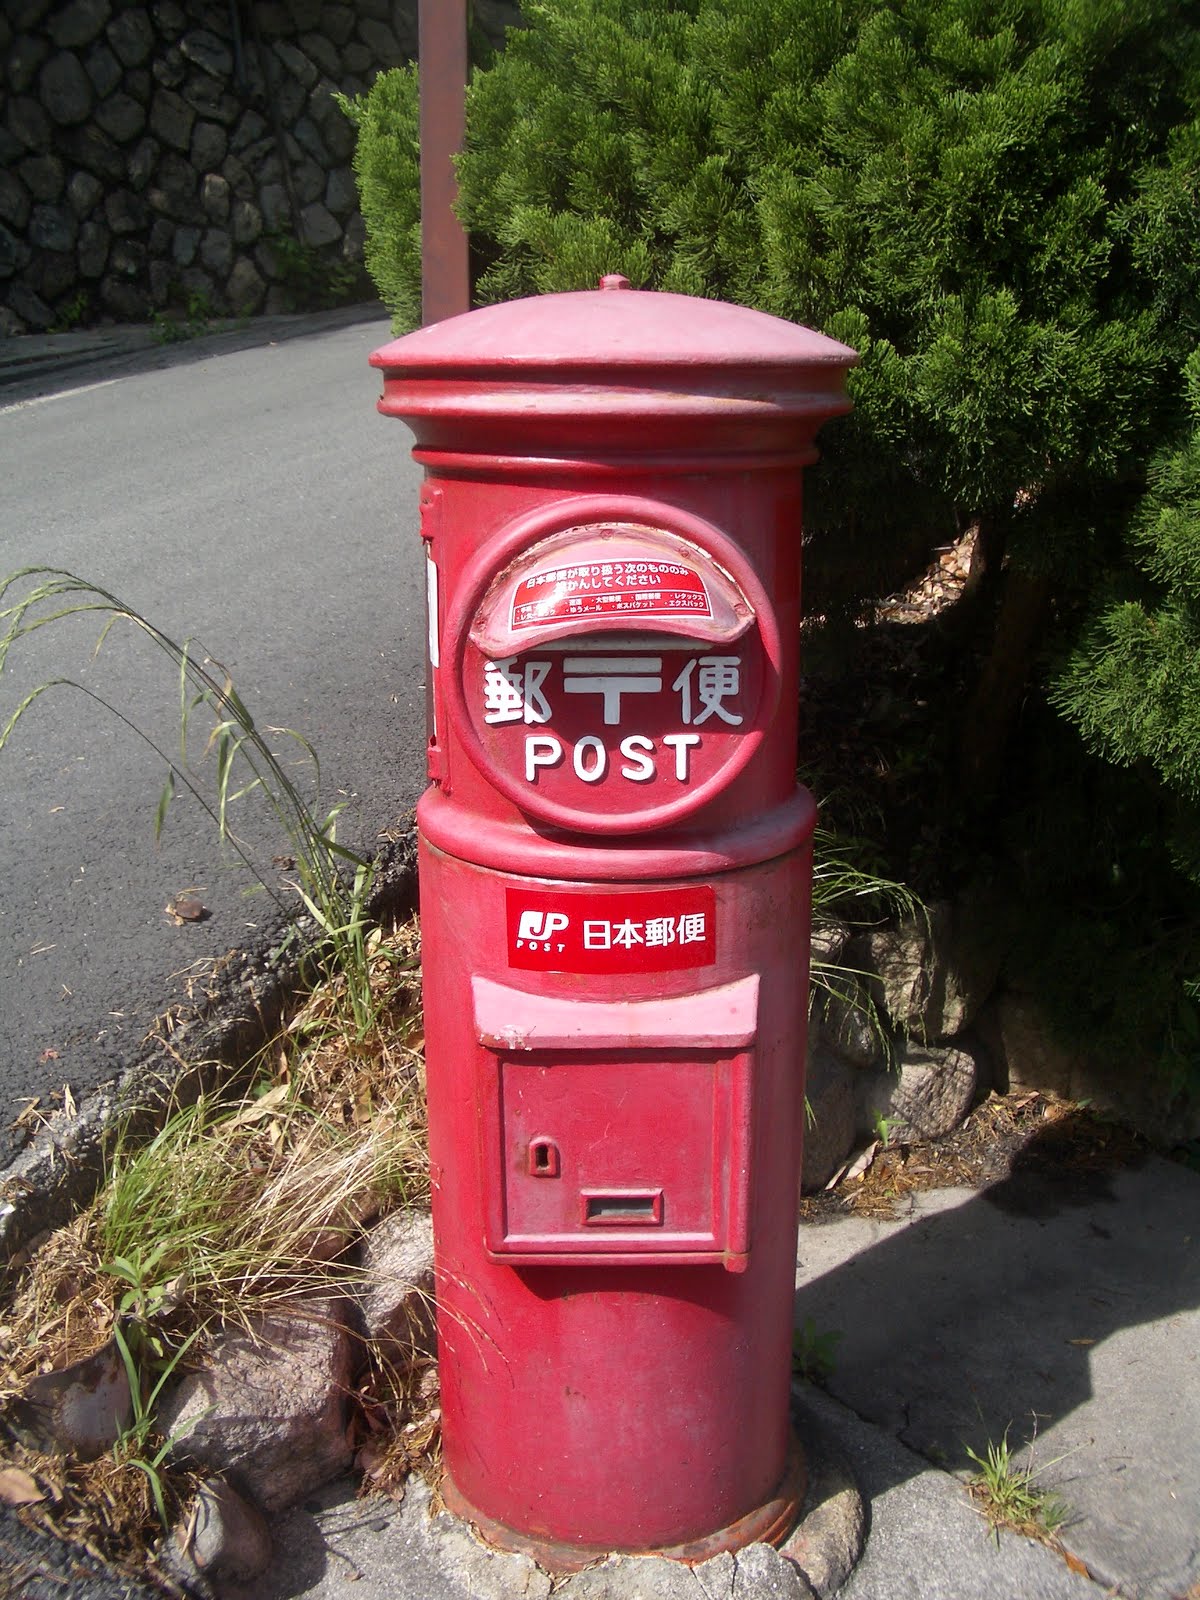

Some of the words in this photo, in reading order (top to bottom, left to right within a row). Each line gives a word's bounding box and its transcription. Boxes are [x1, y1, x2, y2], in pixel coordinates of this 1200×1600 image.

[526, 563, 689, 589] 日本郵便が取り扱う次のもののみ
[569, 603, 602, 613] ゆうメール
[669, 599, 704, 608] エクスパック
[525, 734, 700, 782] POST
[583, 912, 706, 950] 日本郵便
[516, 940, 566, 953] POST
